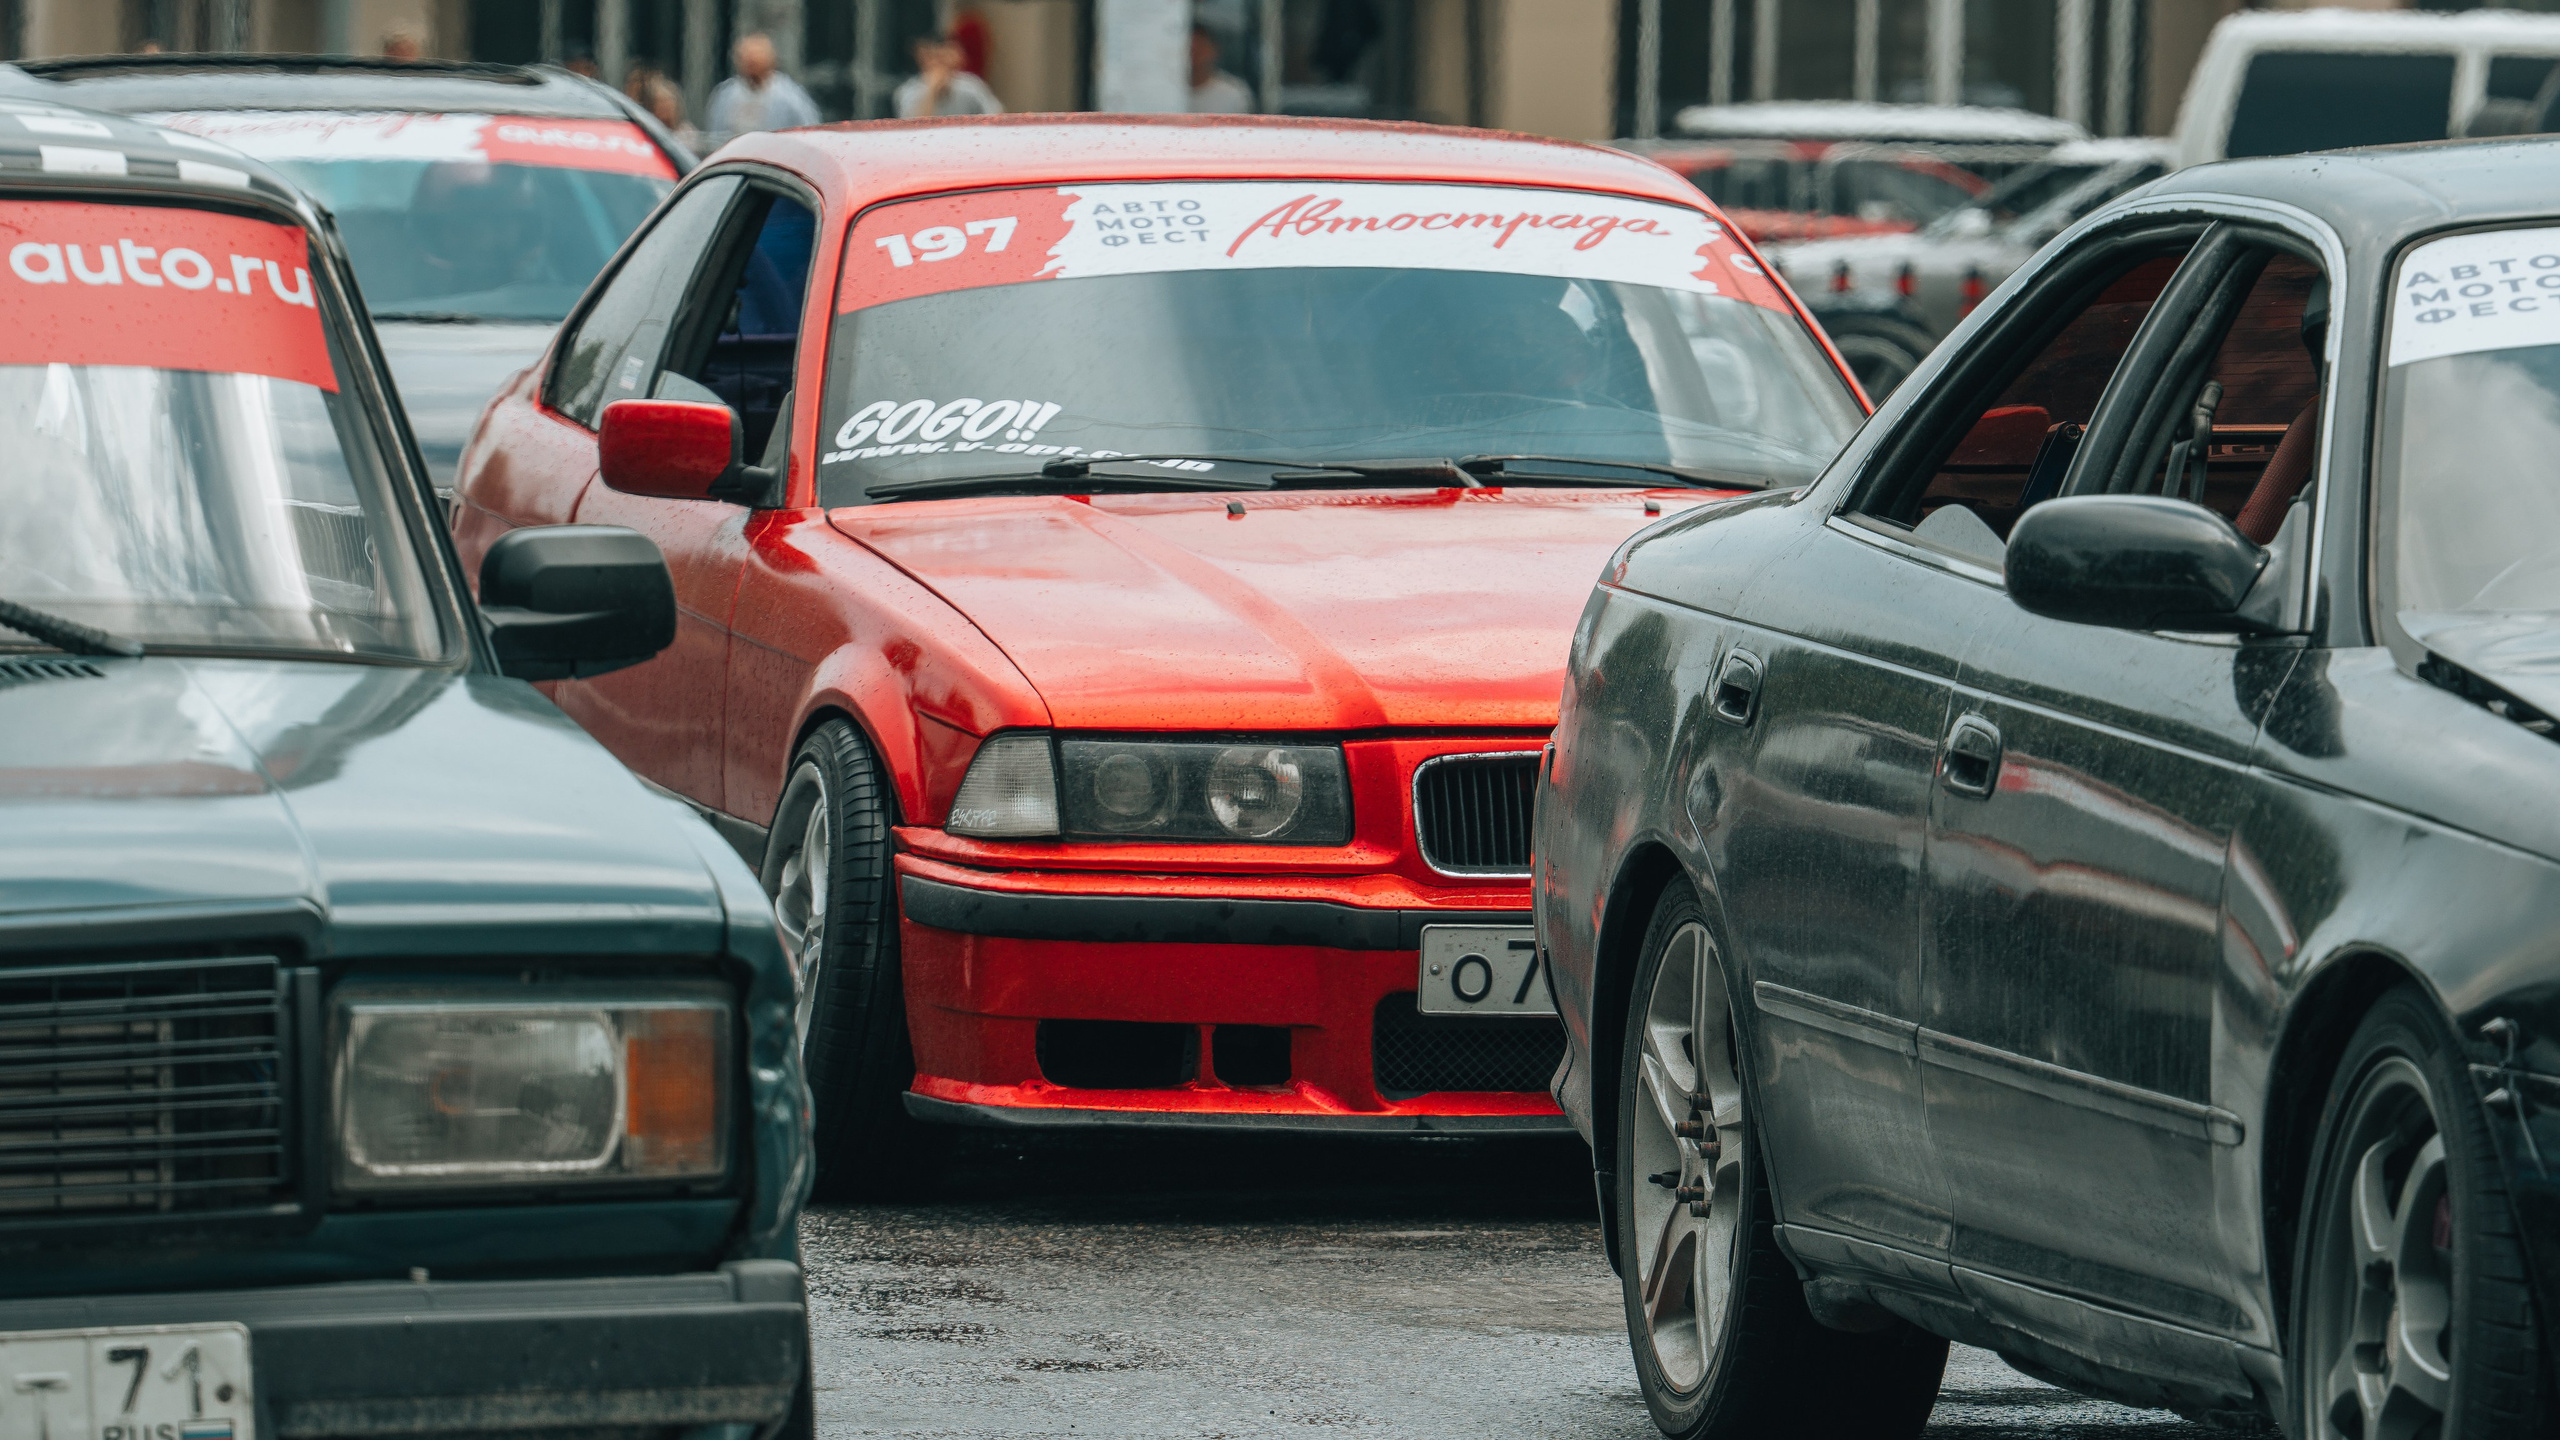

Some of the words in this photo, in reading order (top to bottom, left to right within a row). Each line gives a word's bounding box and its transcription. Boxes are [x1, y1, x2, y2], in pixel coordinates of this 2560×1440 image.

[1092, 199, 1202, 215] АВТО
[1096, 215, 1206, 231] МОТО
[875, 216, 1018, 268] 197
[1101, 229, 1211, 247] ФЕСТ
[1226, 194, 1672, 259] Автострада
[9, 238, 316, 308] auto.ru
[2406, 254, 2560, 288] АВТО
[2410, 274, 2560, 307] МОТО
[834, 398, 1063, 449] GOGO!!
[106, 1341, 203, 1414] 71
[102, 1423, 175, 1440] RUS
